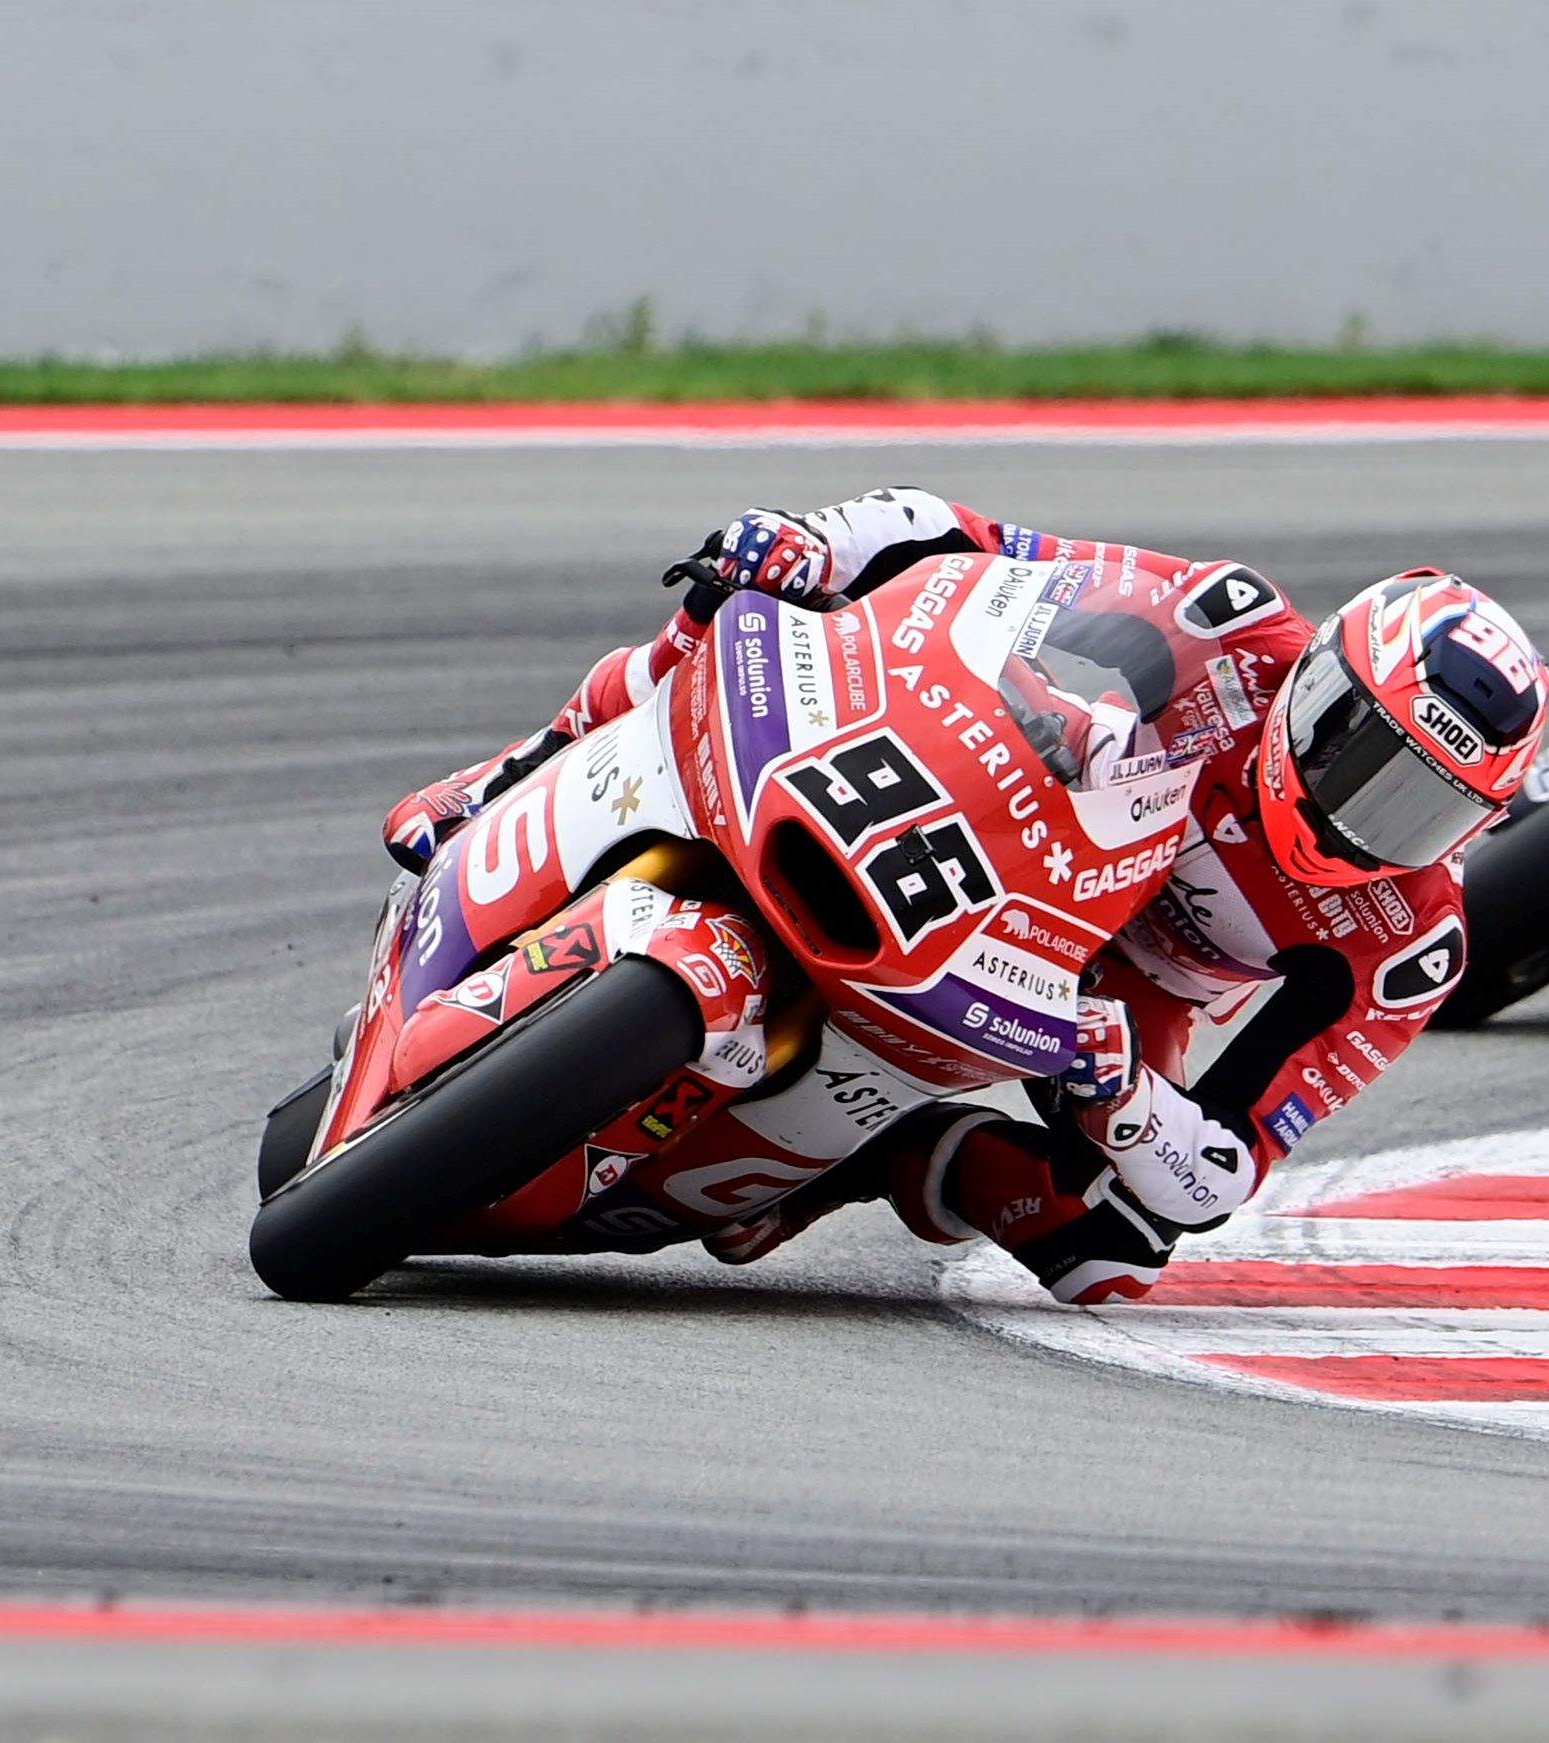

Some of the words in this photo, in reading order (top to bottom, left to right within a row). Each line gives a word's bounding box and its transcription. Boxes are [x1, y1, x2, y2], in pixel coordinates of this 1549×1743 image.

[892, 553, 974, 655] GASGAS
[745, 637, 772, 719] solunion
[789, 615, 818, 707] ASTERIUS
[841, 632, 867, 712] POLARCUBE
[887, 664, 1049, 850] ASTERIUS
[1372, 702, 1404, 737] TRADE
[1405, 733, 1453, 781] WATCHES
[1453, 778, 1466, 795] UK
[1466, 789, 1484, 805] LTD
[1418, 701, 1479, 761] SHOEI
[778, 730, 1002, 950] 96
[1072, 833, 1181, 903] GASGAS
[1349, 891, 1390, 945] solunion
[1372, 880, 1412, 931] SHOEI
[971, 950, 1055, 1002] ASTERIUS
[1028, 925, 1090, 964] POLARCUBE
[990, 1015, 1061, 1055] solunion
[1154, 1140, 1220, 1210] solunion
